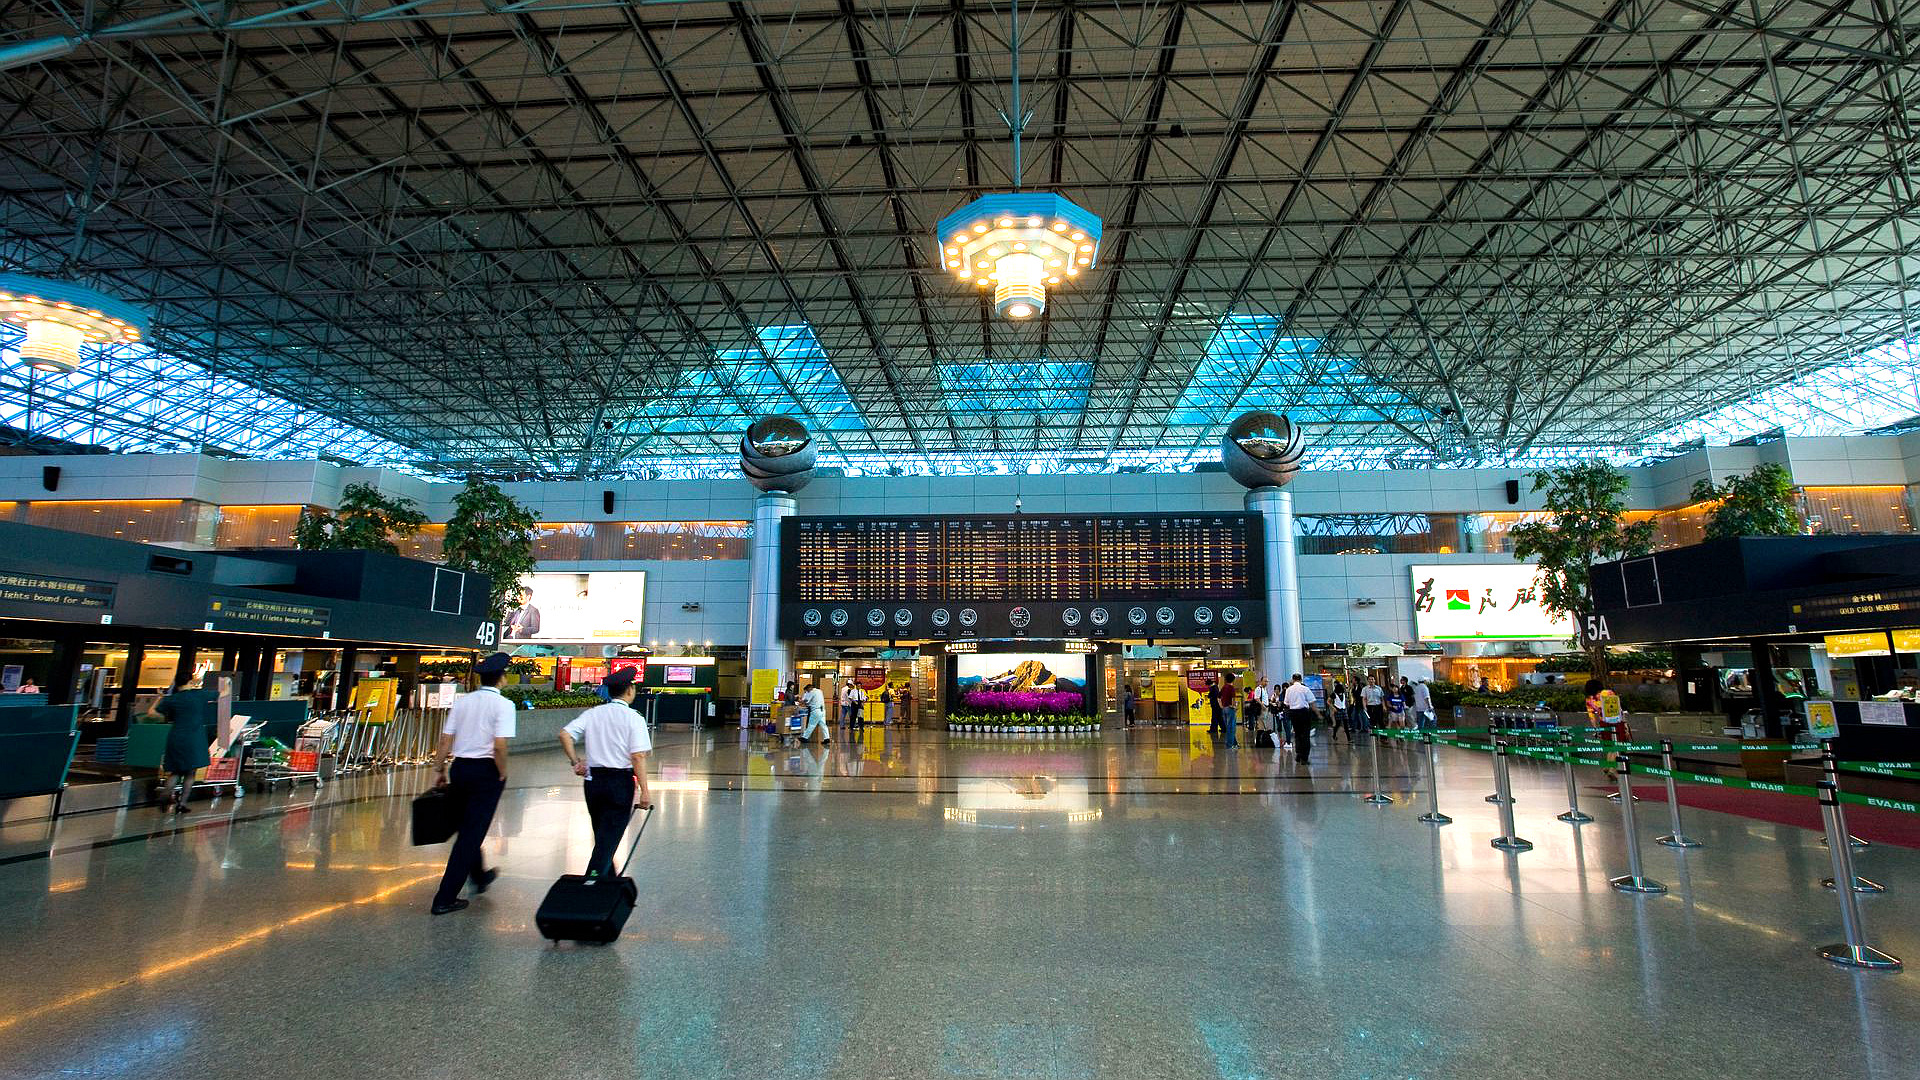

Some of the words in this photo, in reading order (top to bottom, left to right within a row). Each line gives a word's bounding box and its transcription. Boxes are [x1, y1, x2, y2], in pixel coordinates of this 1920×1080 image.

[0, 590, 30, 600] lights
[63, 596, 79, 604] for
[1839, 607, 1855, 615] GOLD
[1856, 605, 1874, 613] CARD
[1875, 603, 1901, 612] MEMBER
[475, 621, 496, 646] 4B
[1587, 614, 1611, 641] 5A
